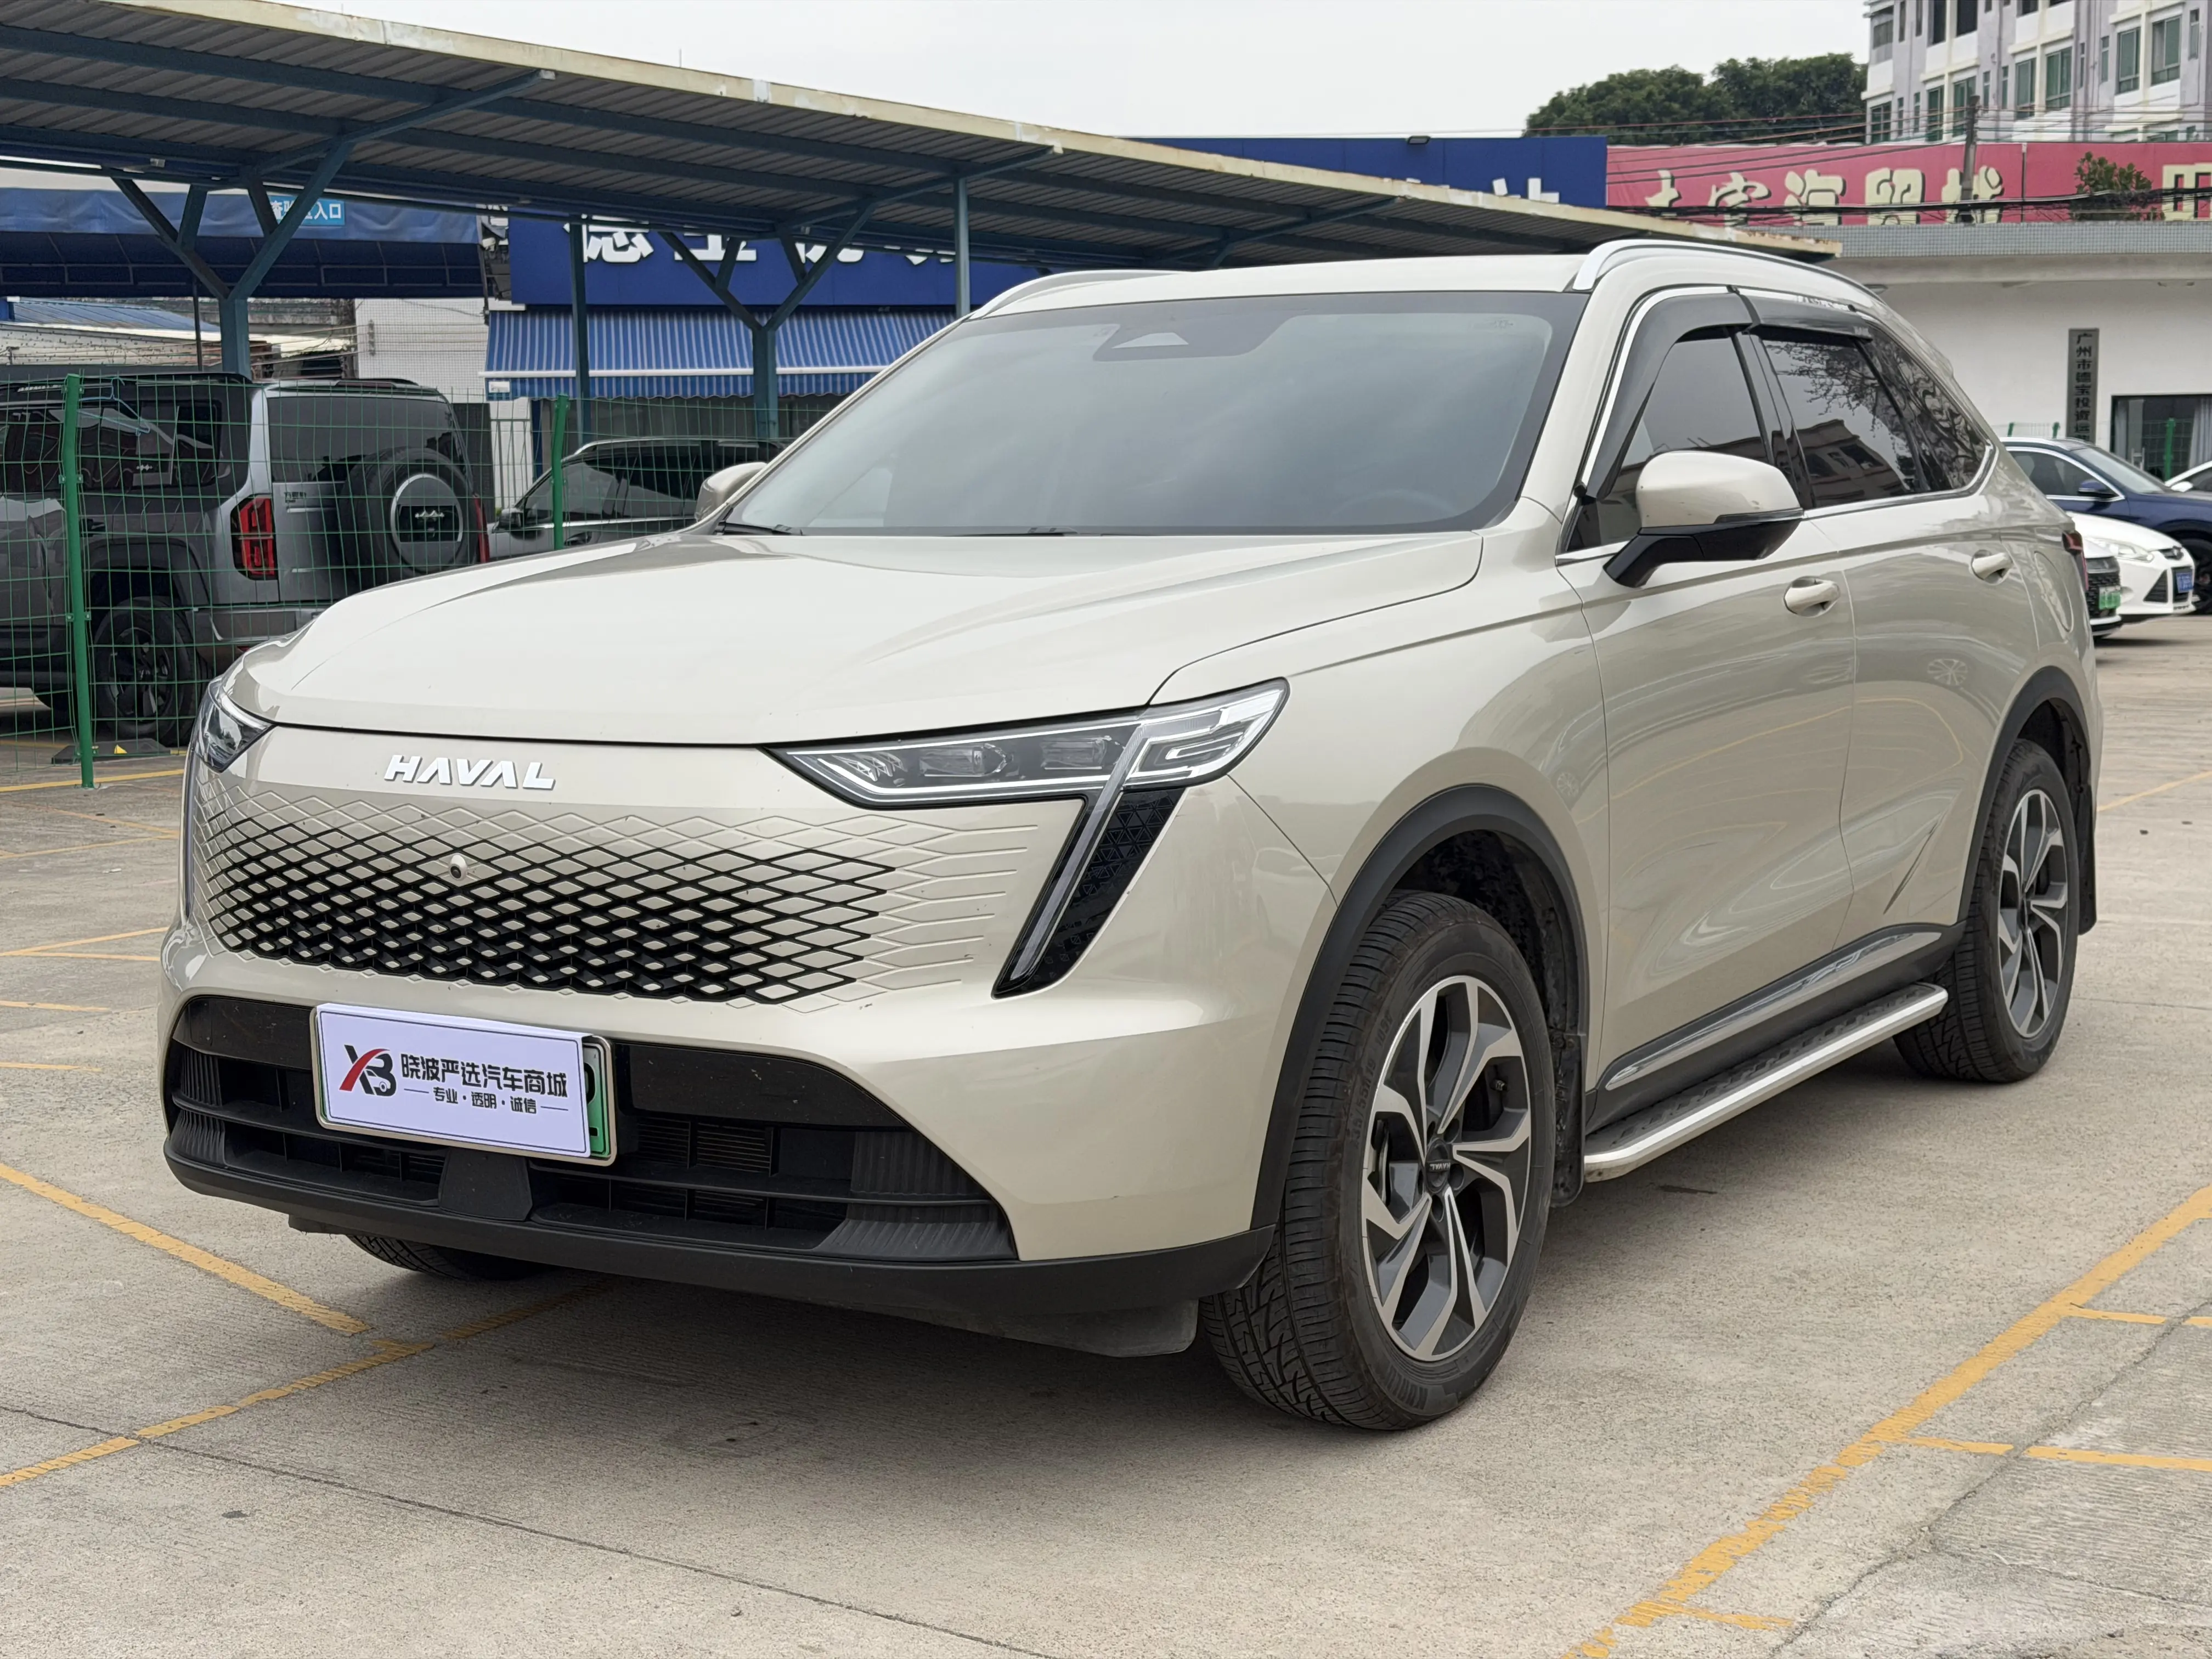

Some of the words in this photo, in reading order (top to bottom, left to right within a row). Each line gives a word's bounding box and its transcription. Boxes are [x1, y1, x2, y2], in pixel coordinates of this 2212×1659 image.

[384, 754, 556, 791] HAVAL
[400, 1053, 568, 1097] 晓波严选汽车商城
